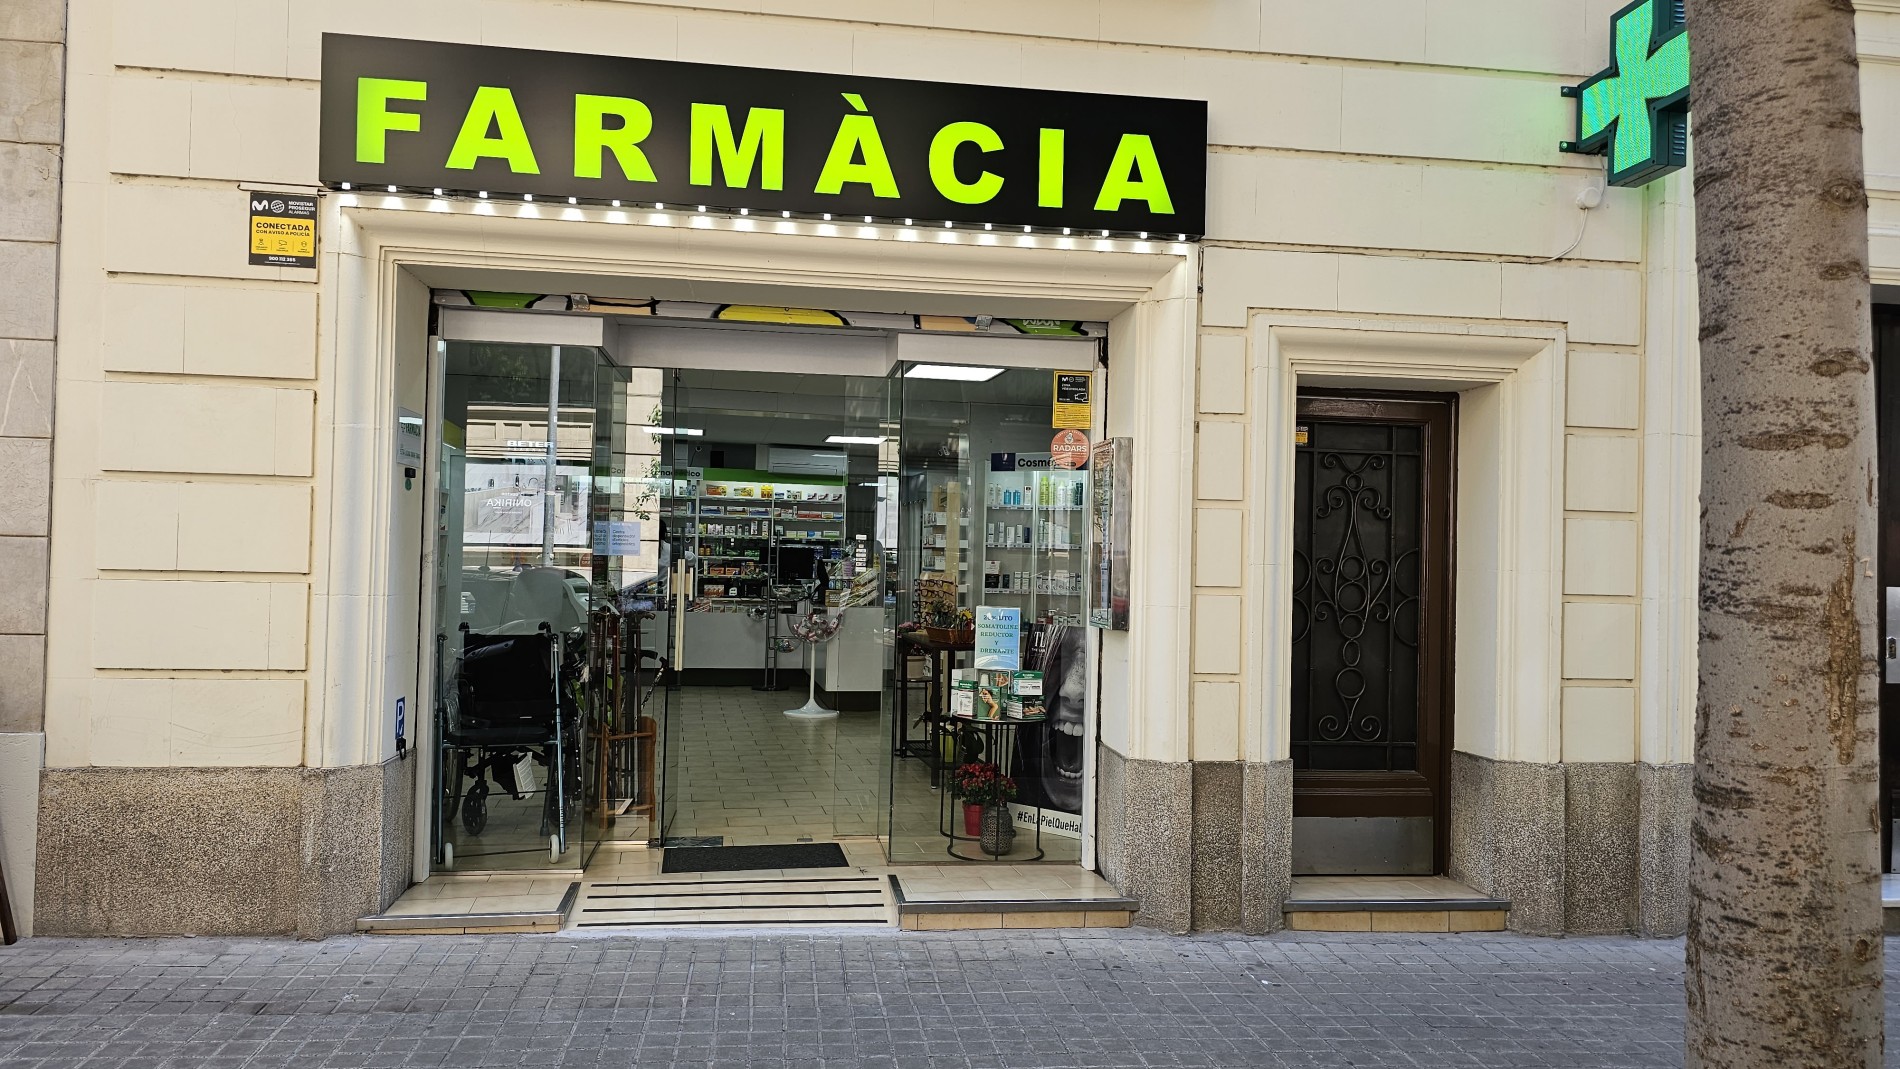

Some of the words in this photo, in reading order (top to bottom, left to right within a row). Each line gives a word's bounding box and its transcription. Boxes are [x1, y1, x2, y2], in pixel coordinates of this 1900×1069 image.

[356, 77, 1175, 216] FARMÀCIA
[256, 222, 310, 231] CONECTADA
[507, 440, 554, 449] BETER
[1053, 445, 1087, 453] RADARS
